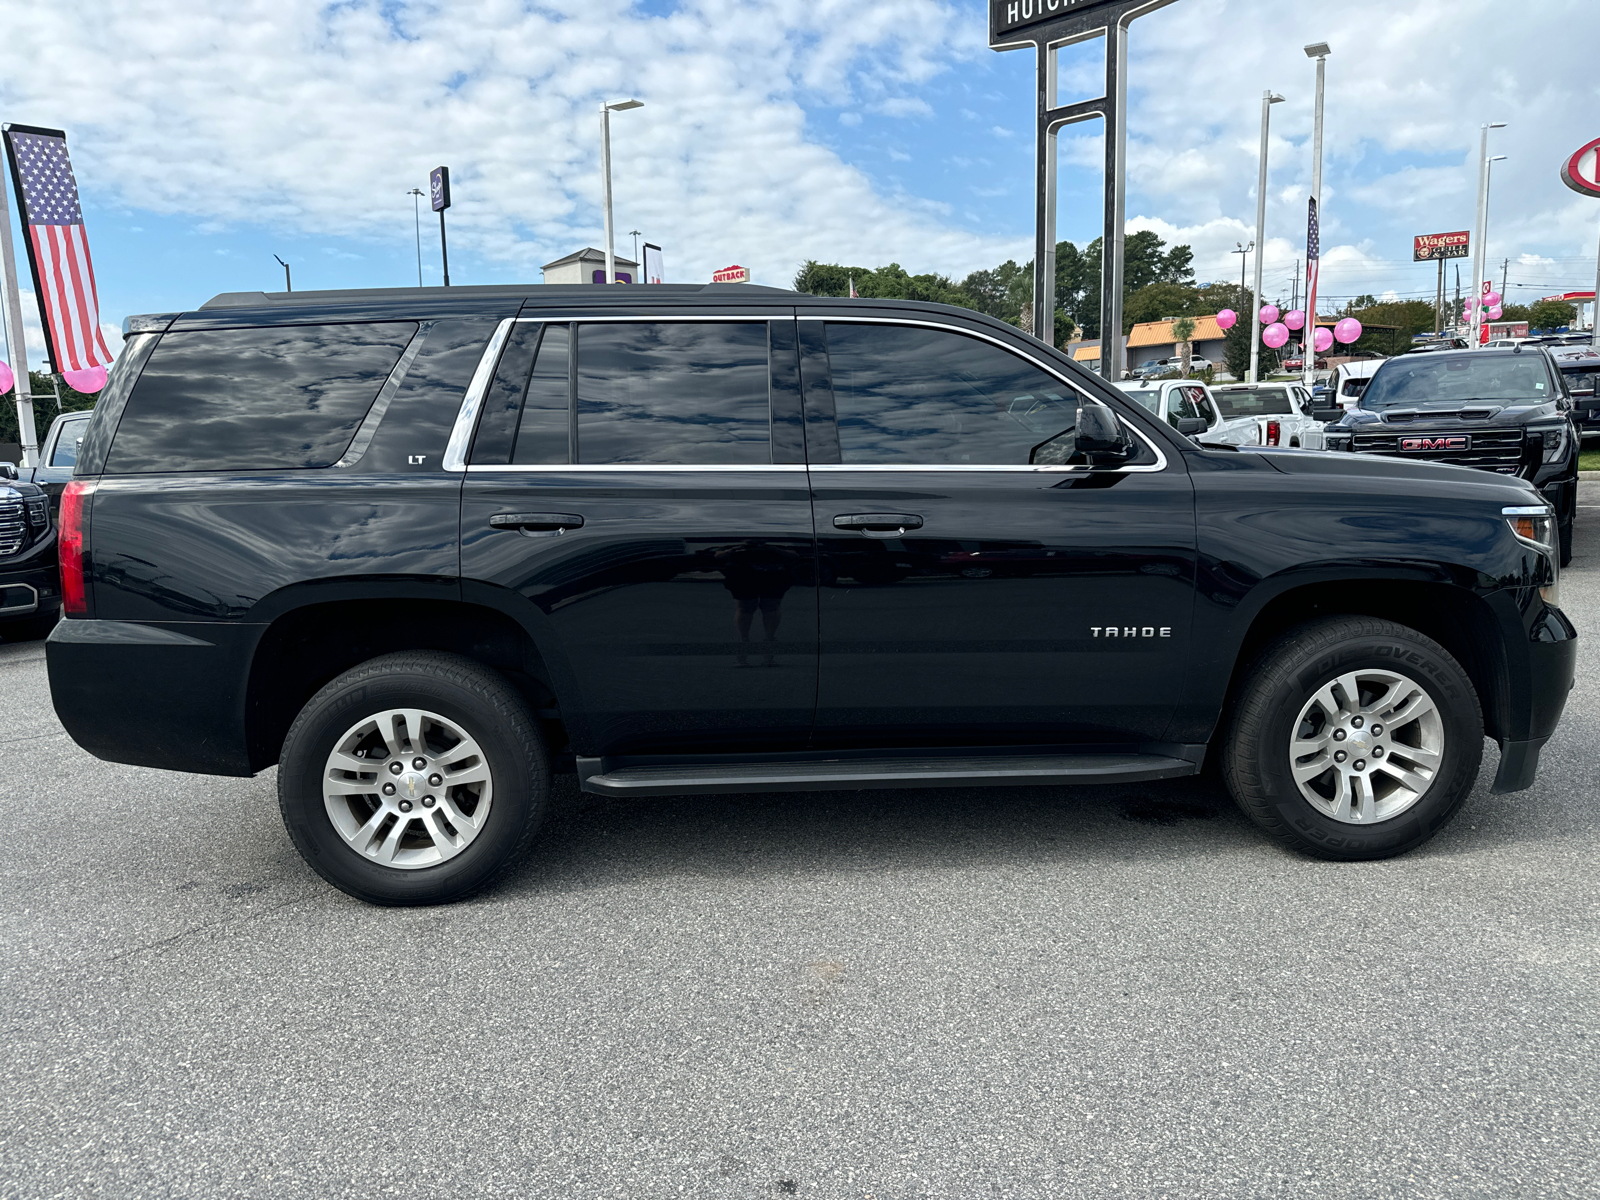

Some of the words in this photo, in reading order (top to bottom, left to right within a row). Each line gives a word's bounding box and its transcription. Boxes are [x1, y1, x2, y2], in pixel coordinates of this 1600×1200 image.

[1417, 235, 1467, 247] Wagers
[713, 271, 745, 283] OUTBACK
[1402, 437, 1466, 450] GMC
[408, 455, 426, 465] LT
[1090, 626, 1172, 638] TAHOE
[1317, 645, 1462, 700] DISCOVERER
[1294, 816, 1401, 850] COOPER
